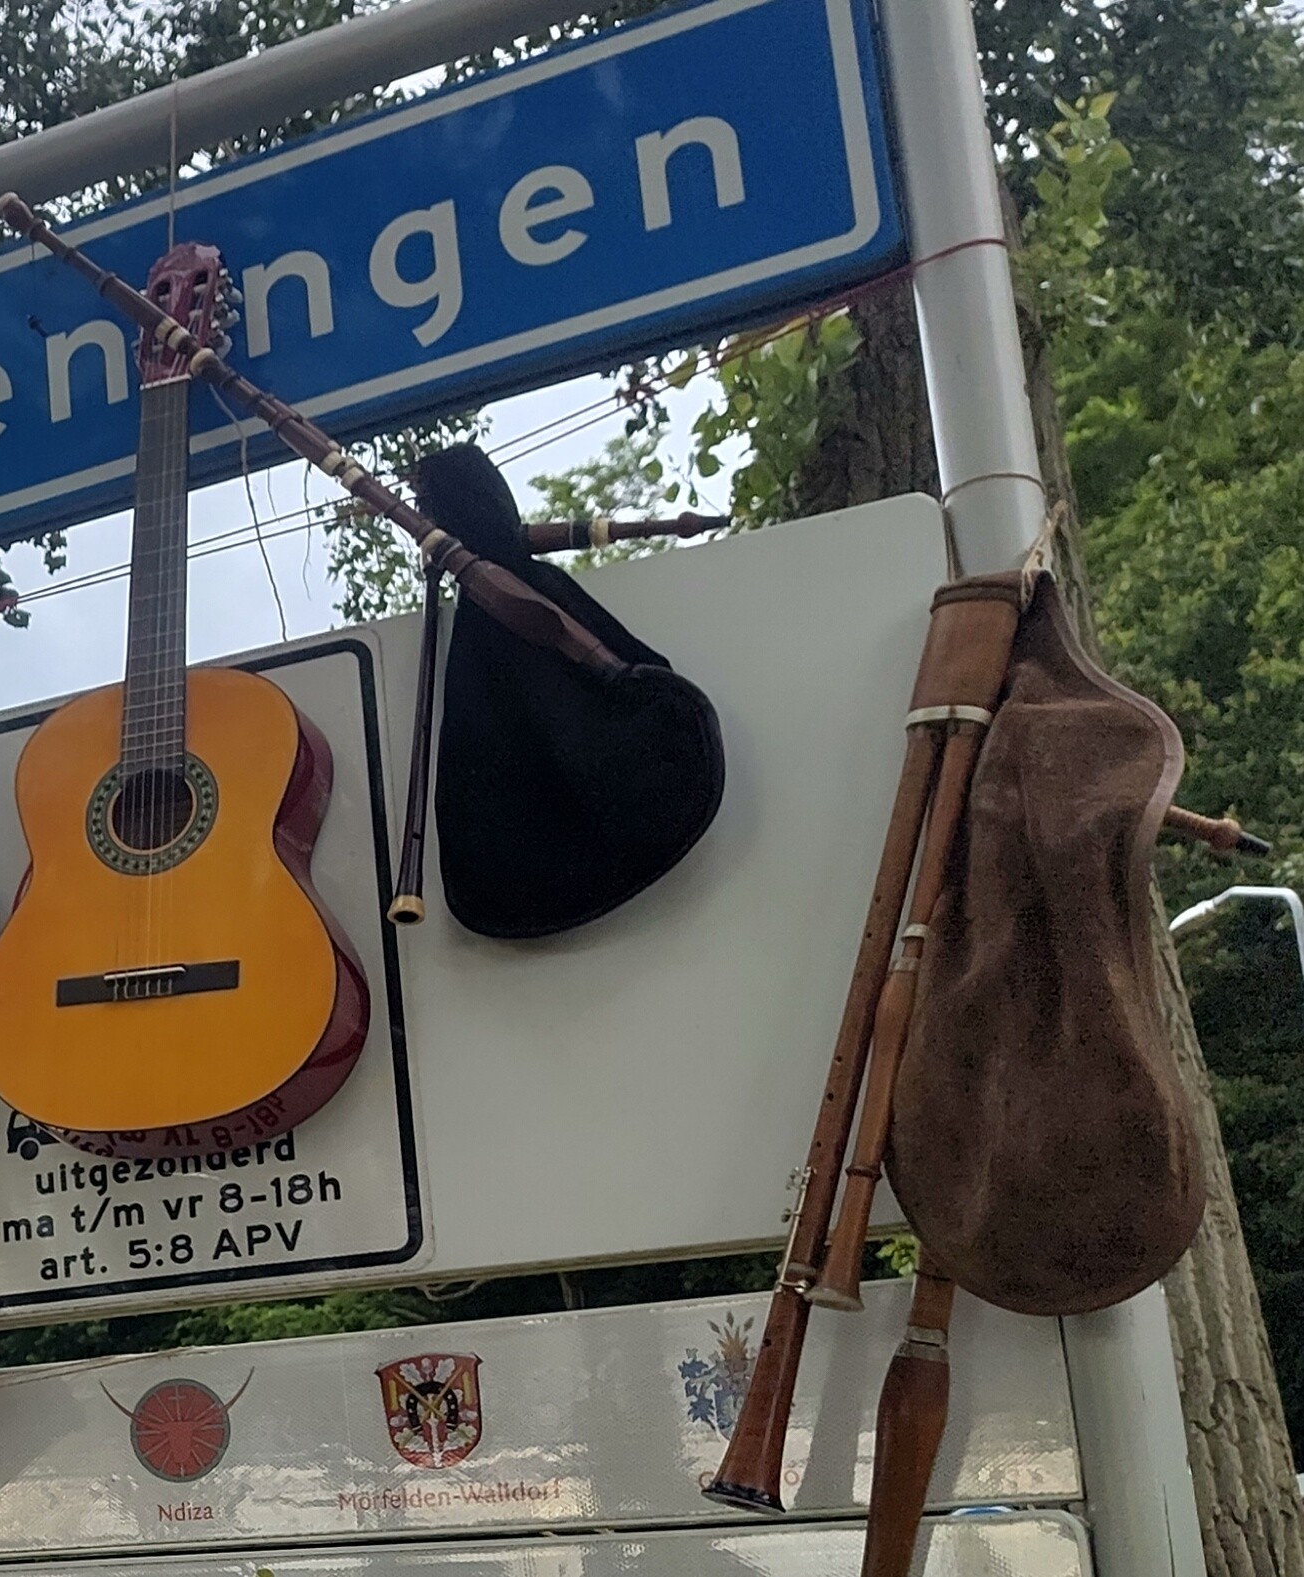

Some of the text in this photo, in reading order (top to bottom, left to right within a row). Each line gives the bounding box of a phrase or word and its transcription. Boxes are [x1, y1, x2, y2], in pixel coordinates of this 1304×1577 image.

[35, 1130, 296, 1197] uitgezonderd
[2, 1170, 342, 1243] ma t/m vr 8-18h
[39, 1219, 303, 1281] art. 5:8 APV
[157, 1501, 214, 1522] Ndiza
[337, 1477, 561, 1511] Mörfelden-Walldorf
